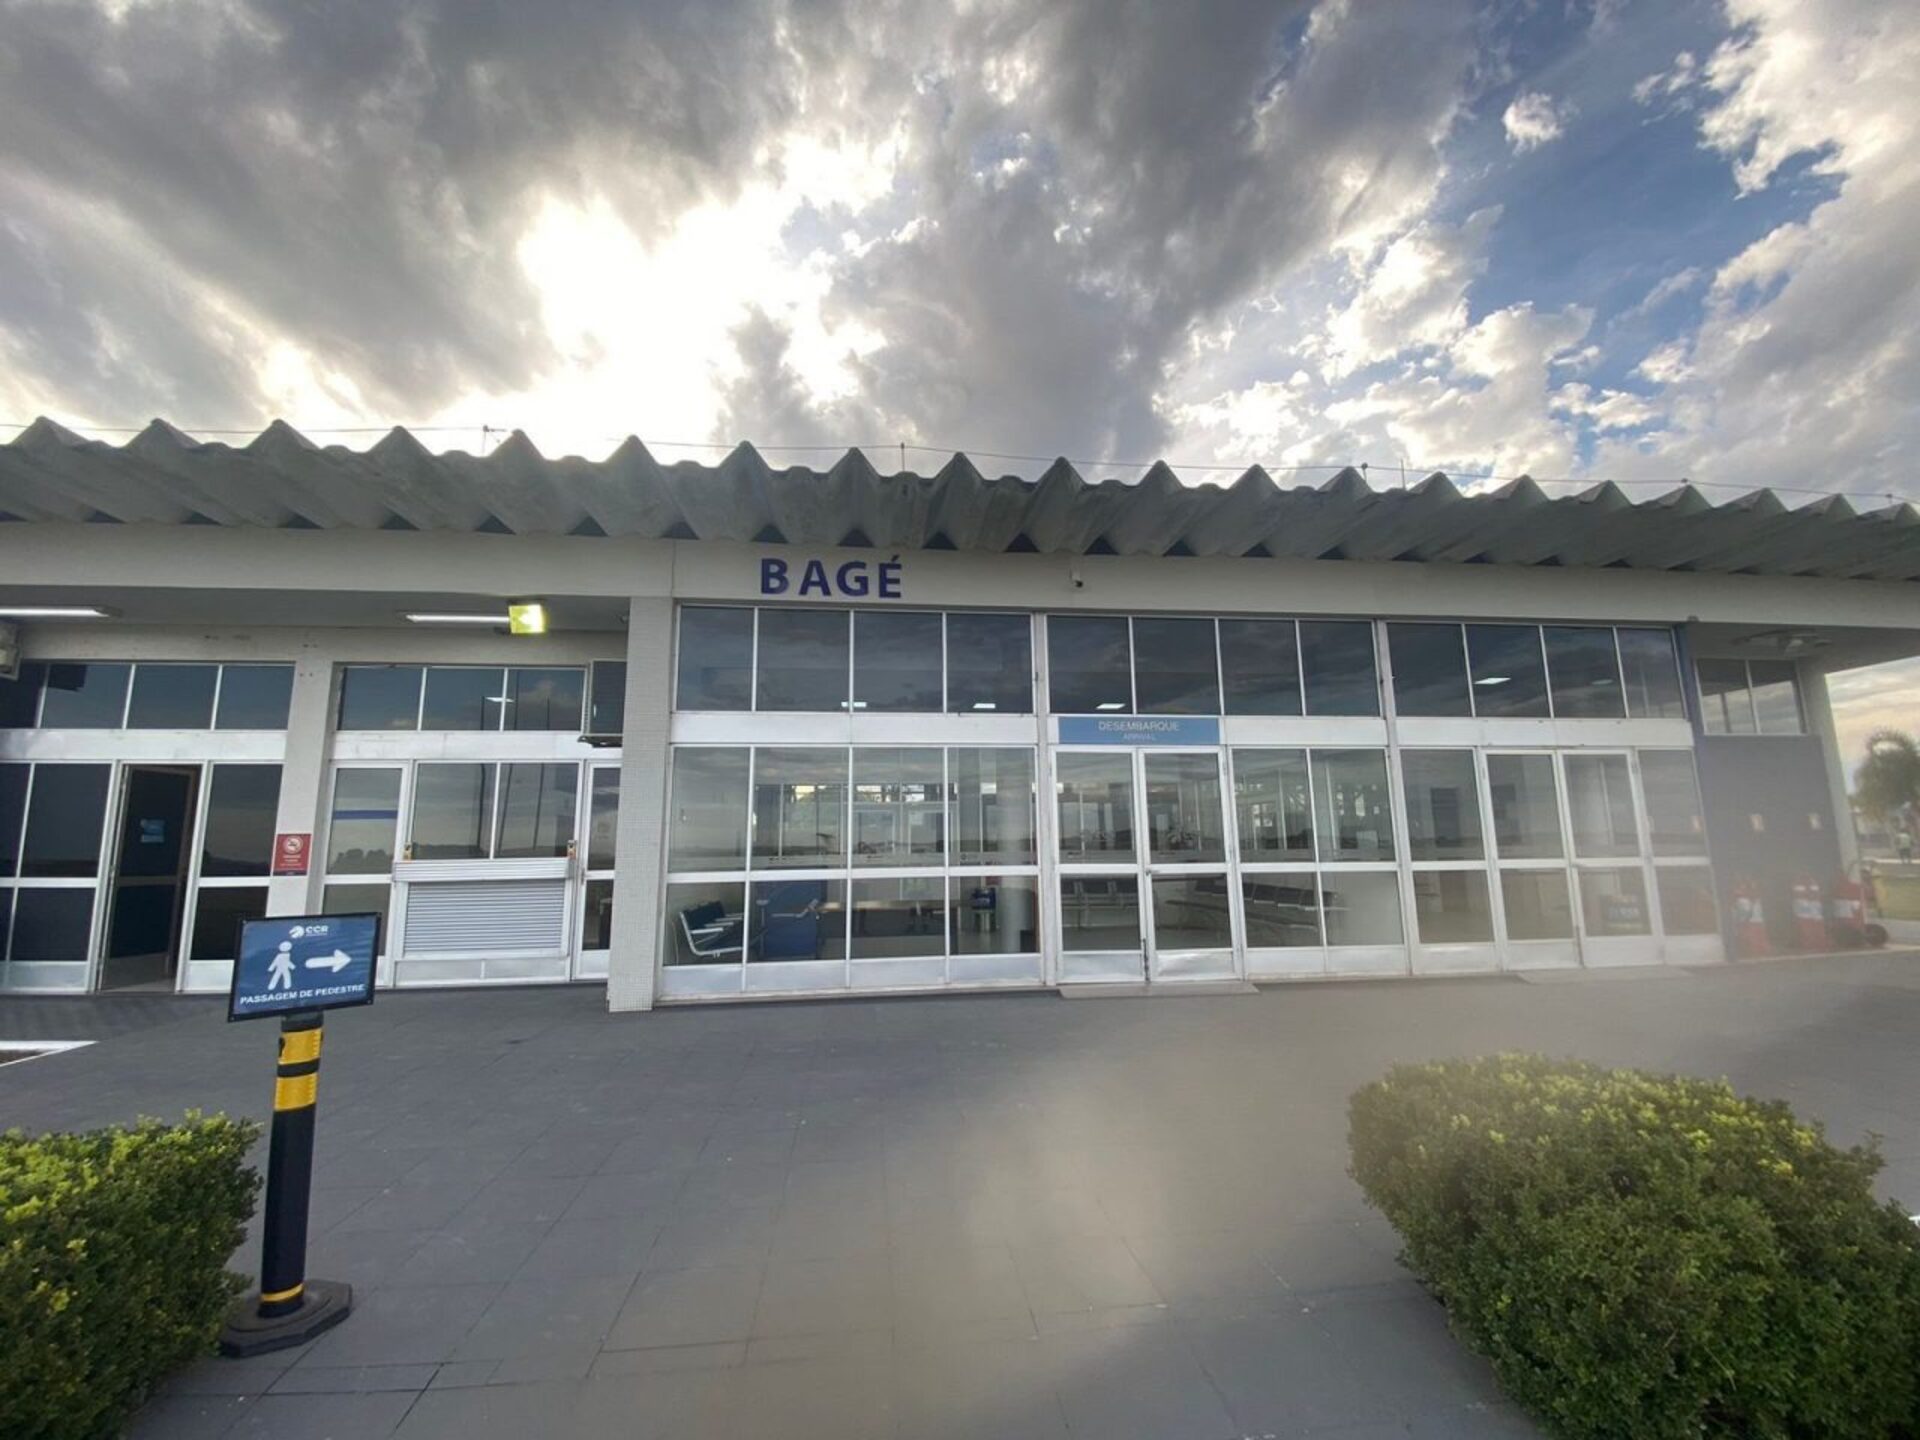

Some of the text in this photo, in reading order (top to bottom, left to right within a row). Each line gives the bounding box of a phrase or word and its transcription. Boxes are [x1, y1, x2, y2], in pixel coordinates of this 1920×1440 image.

[761, 554, 902, 598] BAGÉ
[1098, 721, 1180, 731] DESEMBARQUE
[305, 925, 328, 933] CCR
[240, 984, 364, 1004] PASSAGEM DE PEDESTRE
